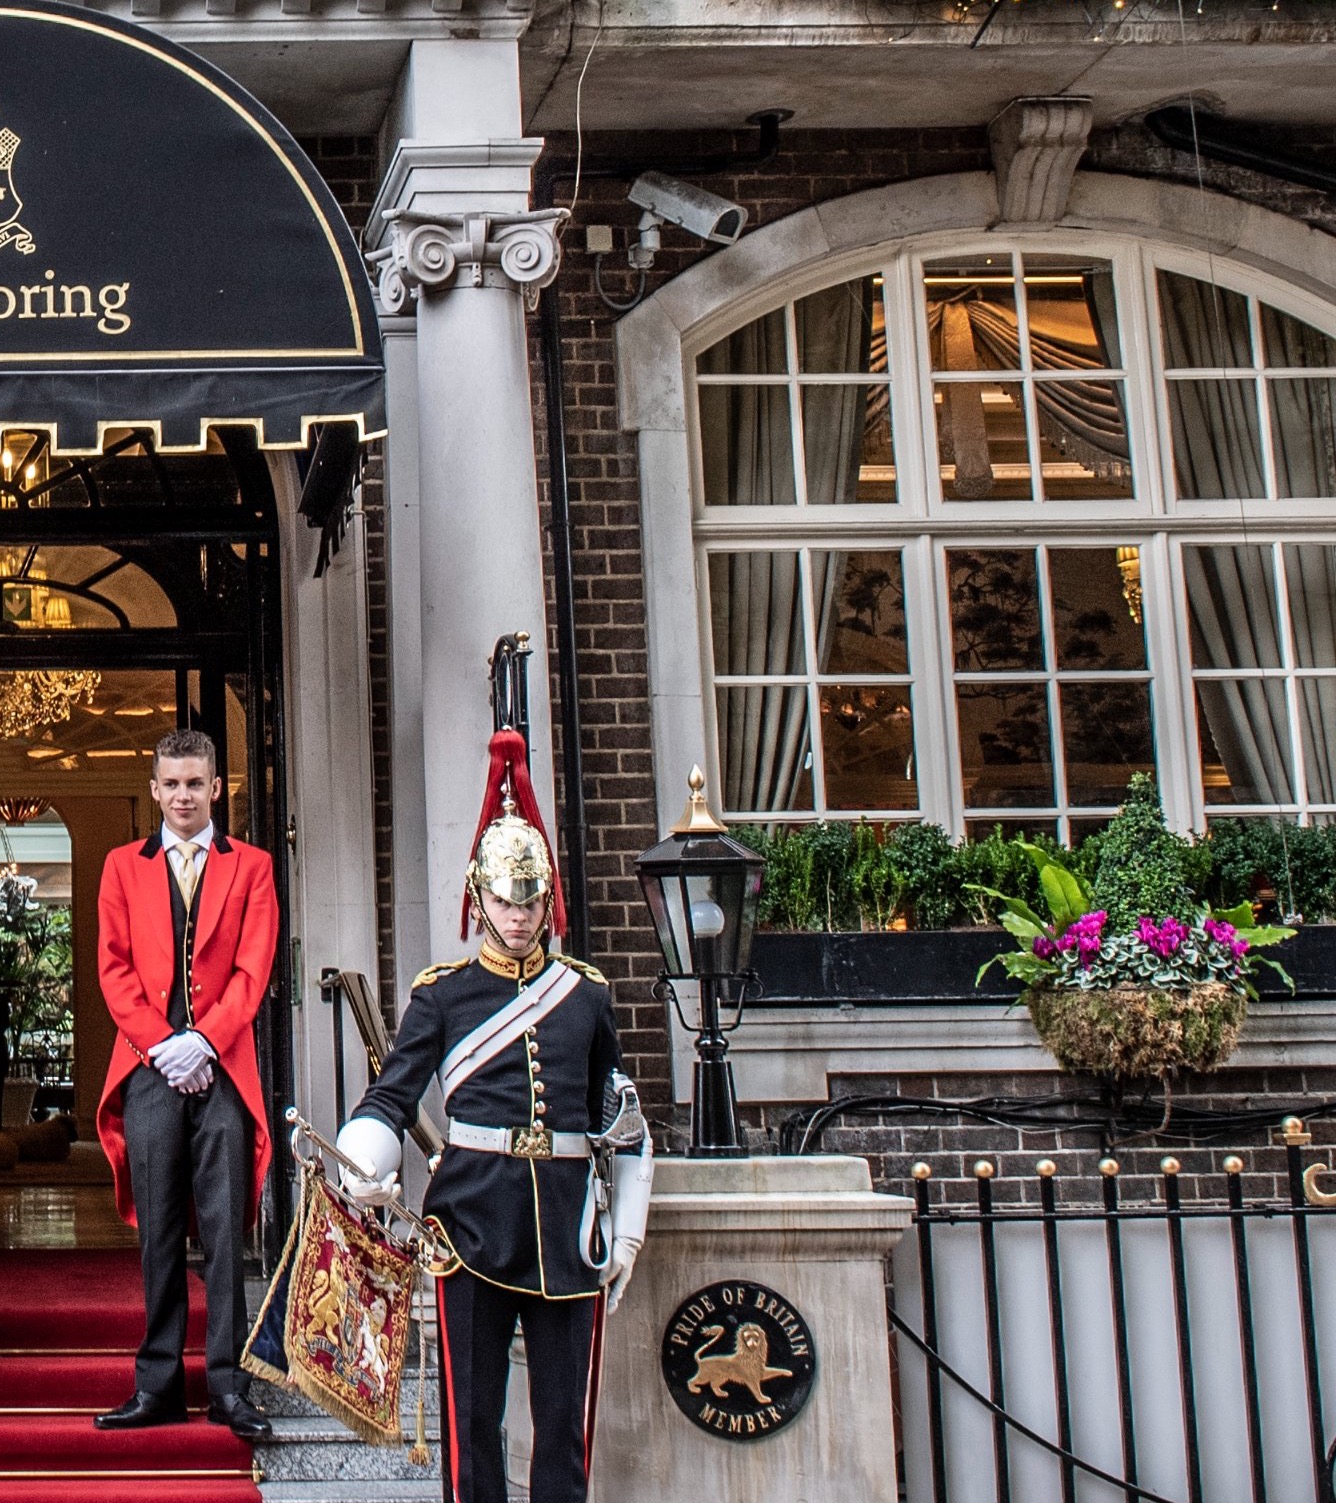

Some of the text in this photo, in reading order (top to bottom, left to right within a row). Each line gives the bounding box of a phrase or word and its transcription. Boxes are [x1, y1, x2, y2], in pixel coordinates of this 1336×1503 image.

[670, 1287, 809, 1356] PRIDE OF BRITAIN
[698, 1402, 782, 1433] MEMBER
